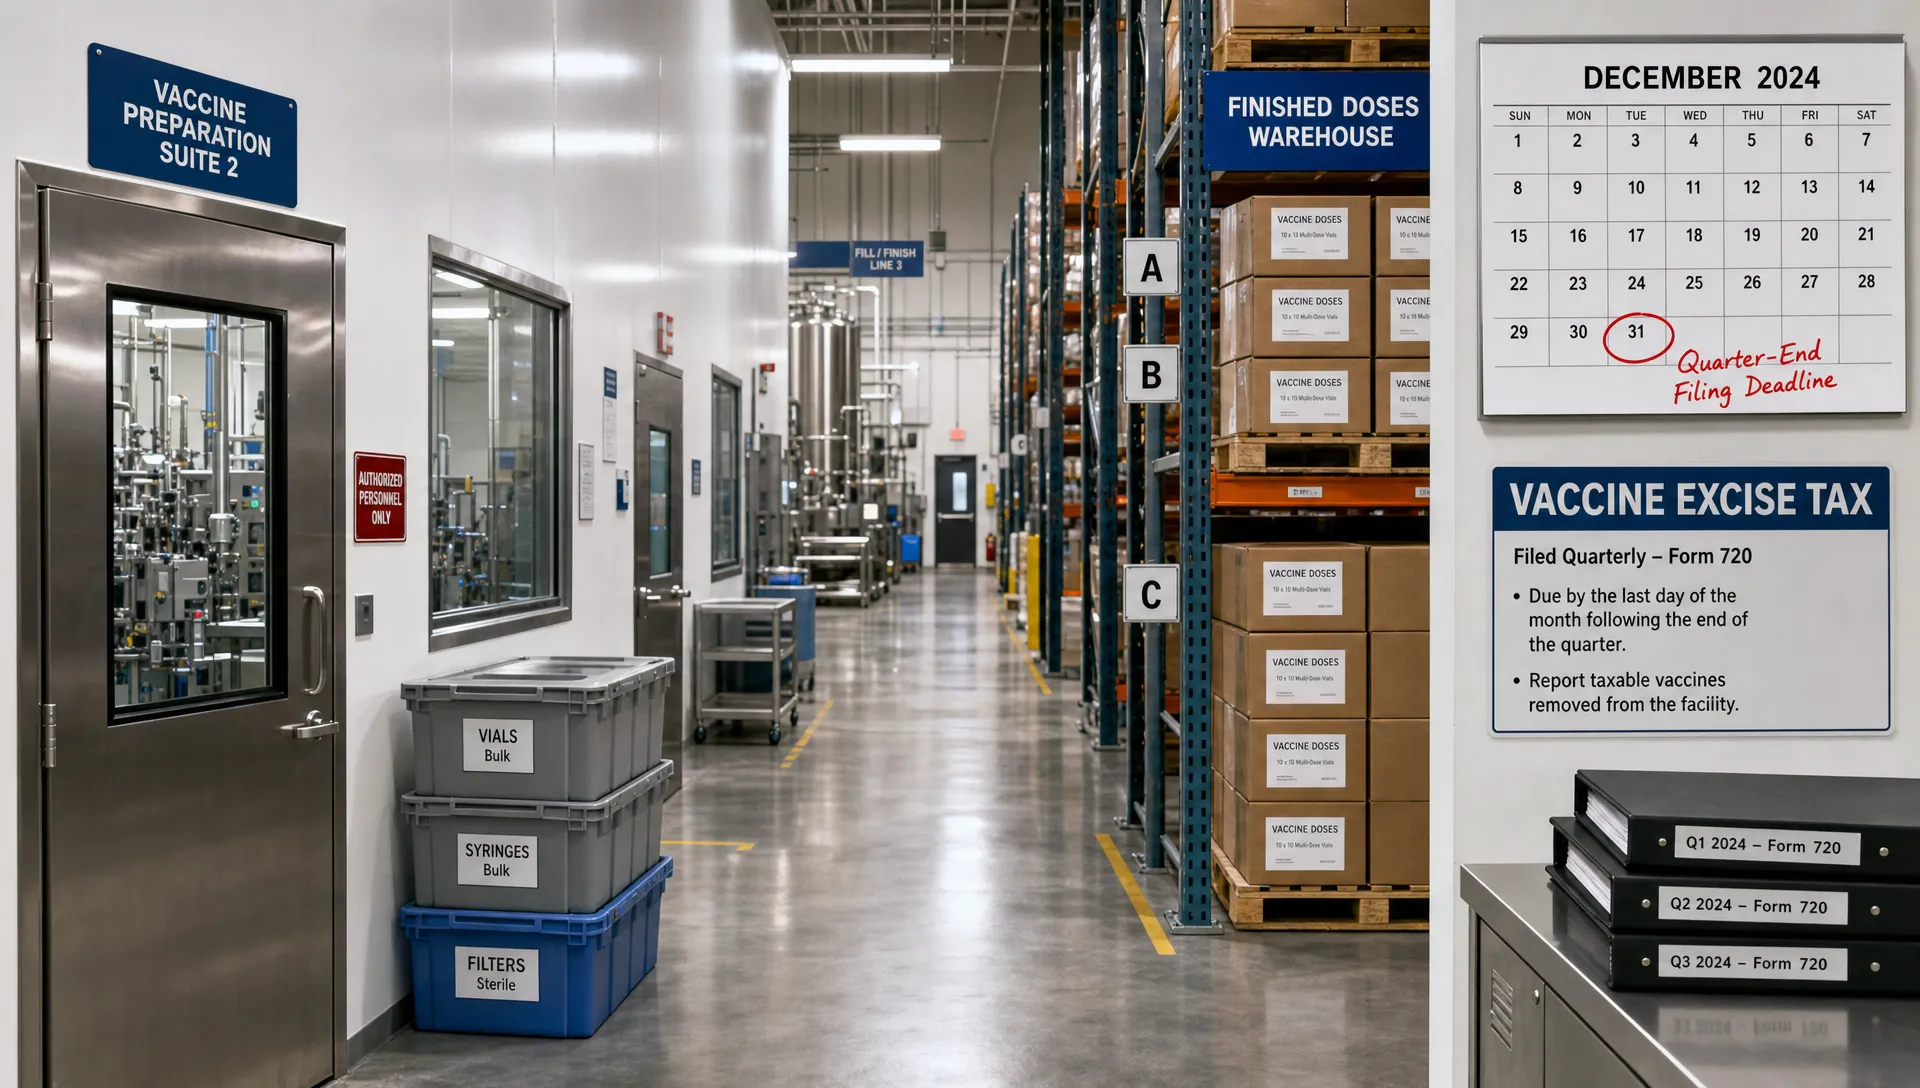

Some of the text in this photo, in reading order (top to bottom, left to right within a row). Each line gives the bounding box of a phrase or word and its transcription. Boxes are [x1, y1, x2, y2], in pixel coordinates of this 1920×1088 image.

[1585, 65, 1820, 89] DECEMBER 2024
[153, 79, 247, 124] VACCINE
[1229, 96, 1419, 117] FINISHED DOSES
[1509, 110, 1876, 120] SUN MON TUE WED THU FRI SAT
[123, 102, 271, 158] PREPARATION
[1248, 126, 1393, 147] WAREHOUSE
[1514, 132, 1871, 147] 1 2 3 4 5 6 7
[159, 141, 239, 178] SUITE 2
[1514, 179, 1875, 195] 8 9 10 11 12 13 14
[1277, 215, 1342, 224] VACCINE DOSES
[1511, 227, 1873, 243] 15 16 17 18 19 20 21
[855, 248, 876, 258] FILL
[883, 248, 916, 258] FINISH
[870, 260, 902, 270] LINE 3
[1141, 254, 1163, 282] A
[1510, 274, 1875, 291] 22 23 24 25 26 27 28
[1278, 297, 1343, 305] VACCINE DOSES
[1510, 324, 1643, 339] 29 30 31
[1677, 338, 1822, 374] Quarter-End
[1142, 361, 1161, 389] B
[1276, 378, 1342, 387] VACCINE DOSES
[1673, 371, 1838, 408] Filing Deadline
[358, 470, 403, 488] AUTHORIZED
[1509, 482, 1873, 516] VACCINE EXCISE TAX
[371, 510, 391, 525] ONLY
[1515, 547, 1556, 564] Filed
[1563, 547, 1646, 568] Quarterly
[1669, 548, 1713, 564] Form
[1720, 547, 1752, 564] 720
[1270, 569, 1336, 578] VACCINE DOSES
[1142, 580, 1161, 609] C
[1530, 587, 1736, 606] Due by the last day of the
[1530, 611, 1749, 631] month following the end of
[1529, 636, 1625, 656] the quarter.
[1272, 658, 1339, 666] VACCINE DOSES
[1530, 671, 1726, 691] Report taxable vaccines
[1530, 696, 1600, 712] removed
[1606, 696, 1644, 712] from
[1649, 696, 1676, 712] the
[478, 728, 517, 743] VIALS
[1273, 742, 1339, 750] VACCINE DOSES
[485, 749, 510, 762] Bulk
[1272, 825, 1338, 833] VACCINE DOSES
[466, 843, 529, 859] SYRINGES
[1686, 836, 1704, 850] Q1
[1711, 837, 1746, 850] 2024
[1768, 839, 1805, 853] Form
[1814, 841, 1841, 854] 720
[484, 863, 510, 877] Bulk
[1671, 897, 1690, 911] Q2
[1696, 898, 1732, 911] 2024
[1754, 899, 1791, 913] Form
[1800, 901, 1827, 914] 720
[468, 956, 525, 973] FILTERS
[1671, 955, 1690, 969] Q3
[1696, 956, 1731, 968] 2024
[1754, 957, 1791, 970] Form
[1800, 958, 1827, 970] 720
[477, 977, 516, 991] Sterile
